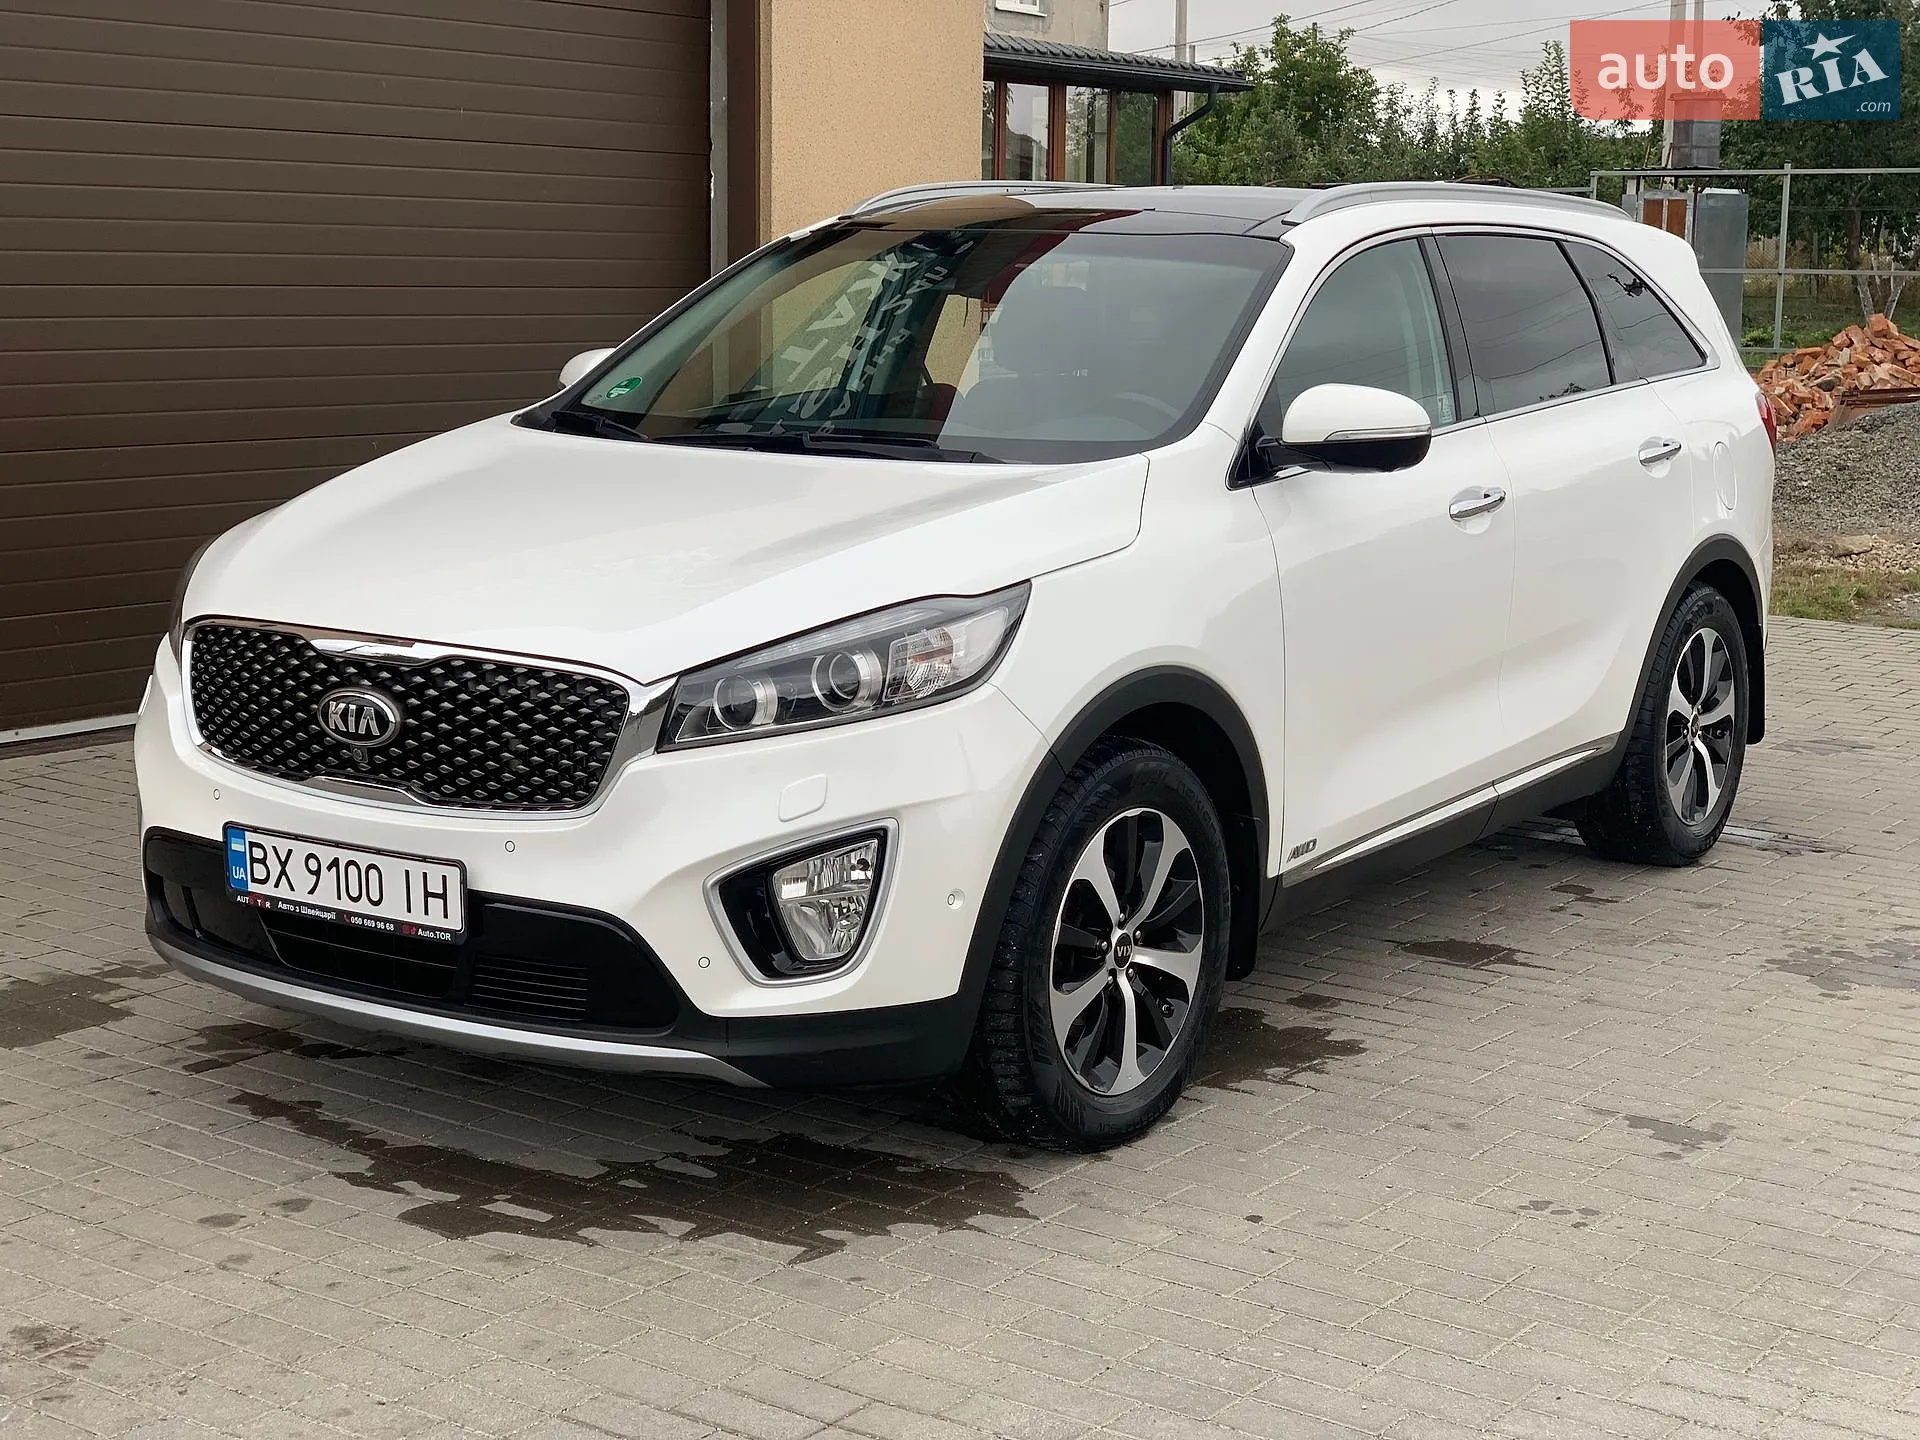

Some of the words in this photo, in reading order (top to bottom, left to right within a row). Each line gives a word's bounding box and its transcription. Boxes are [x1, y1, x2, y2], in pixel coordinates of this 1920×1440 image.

[328, 701, 381, 736] KIA
[232, 865, 247, 881] UA
[248, 840, 296, 893] BX
[304, 852, 384, 907] 9100
[404, 869, 449, 920] IH
[278, 901, 295, 911] Авто
[300, 905, 337, 920] Швейцарії
